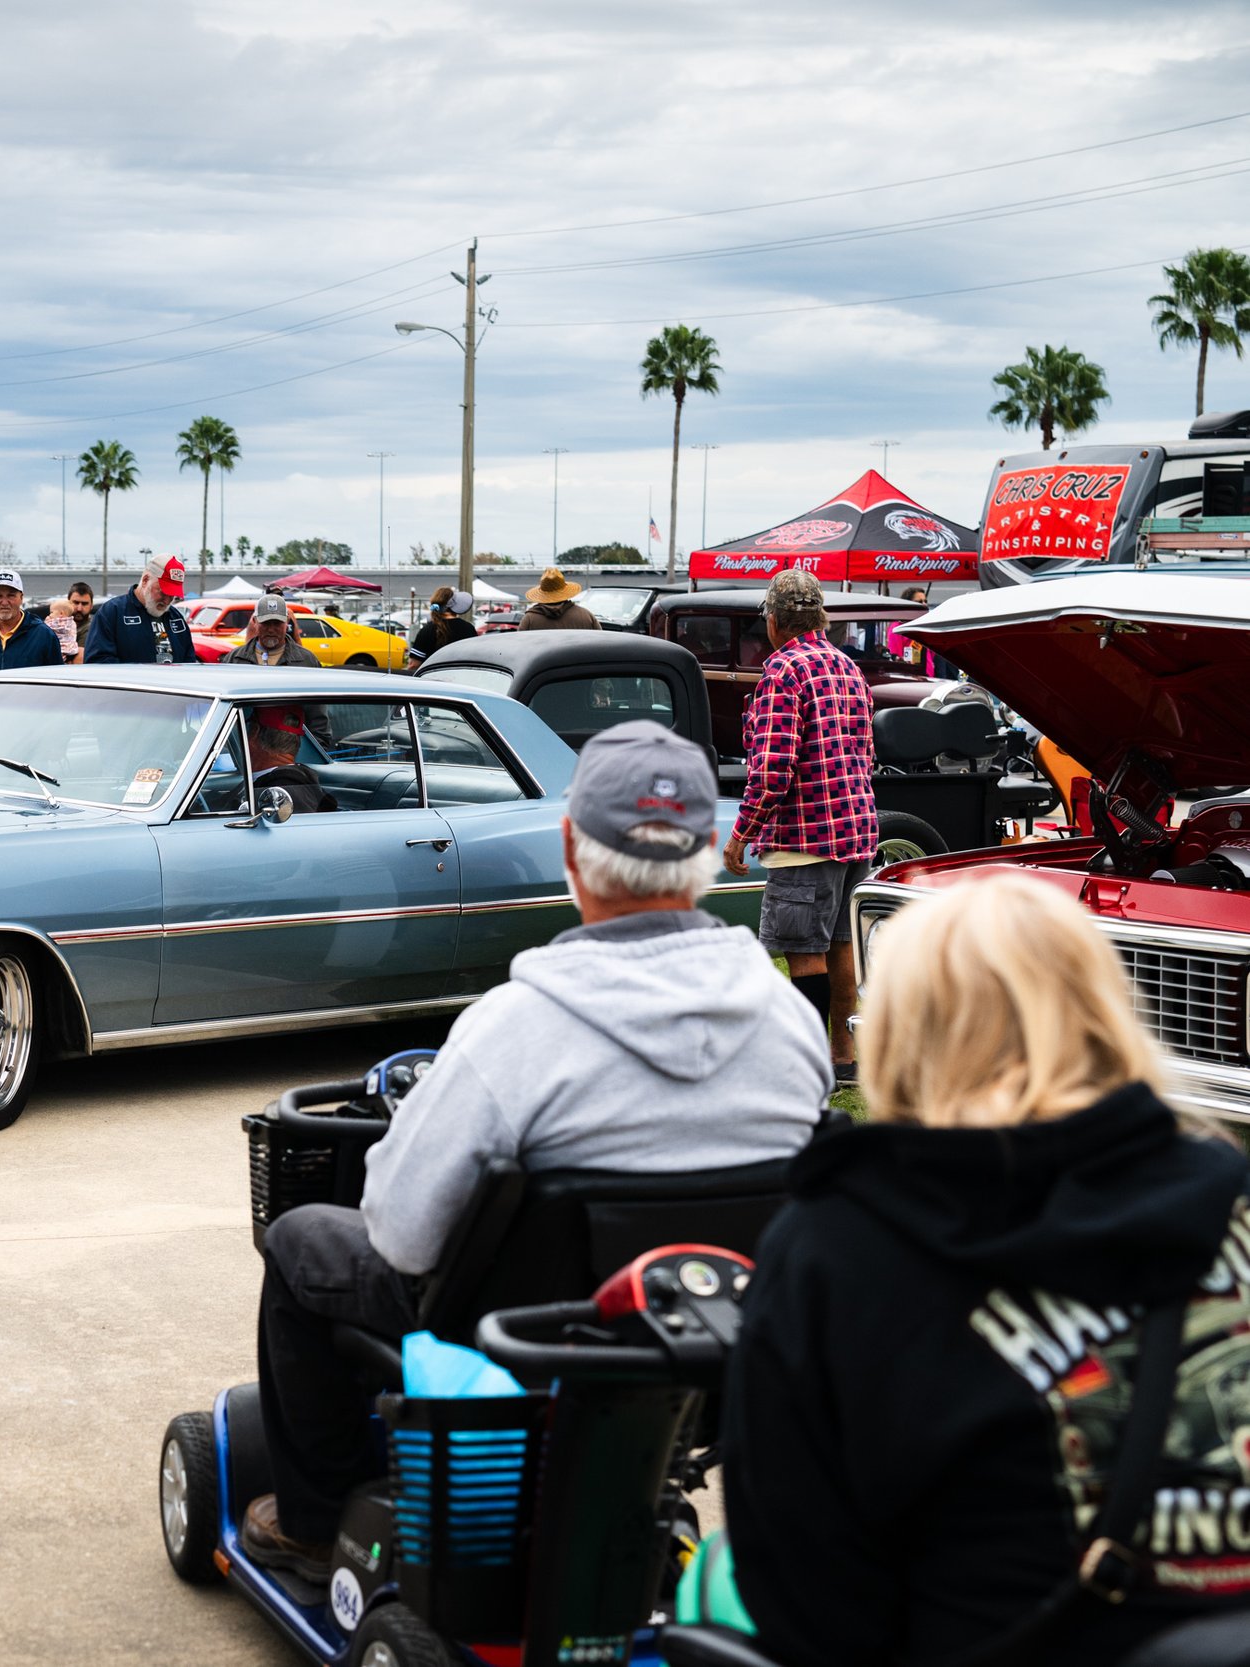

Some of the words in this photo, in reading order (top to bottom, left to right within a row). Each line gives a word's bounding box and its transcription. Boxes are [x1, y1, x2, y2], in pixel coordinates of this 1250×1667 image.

[995, 474, 1054, 505] CHRIS
[1051, 472, 1123, 500] CRUZ
[988, 506, 1108, 537] ARTISTRY
[1032, 519, 1041, 531] &
[986, 536, 1103, 552] PINSTRIPING
[713, 554, 778, 573] Pinstriping
[793, 557, 822, 571] ART
[875, 554, 961, 574] Pinstriping
[335, 1579, 358, 1621] 984
